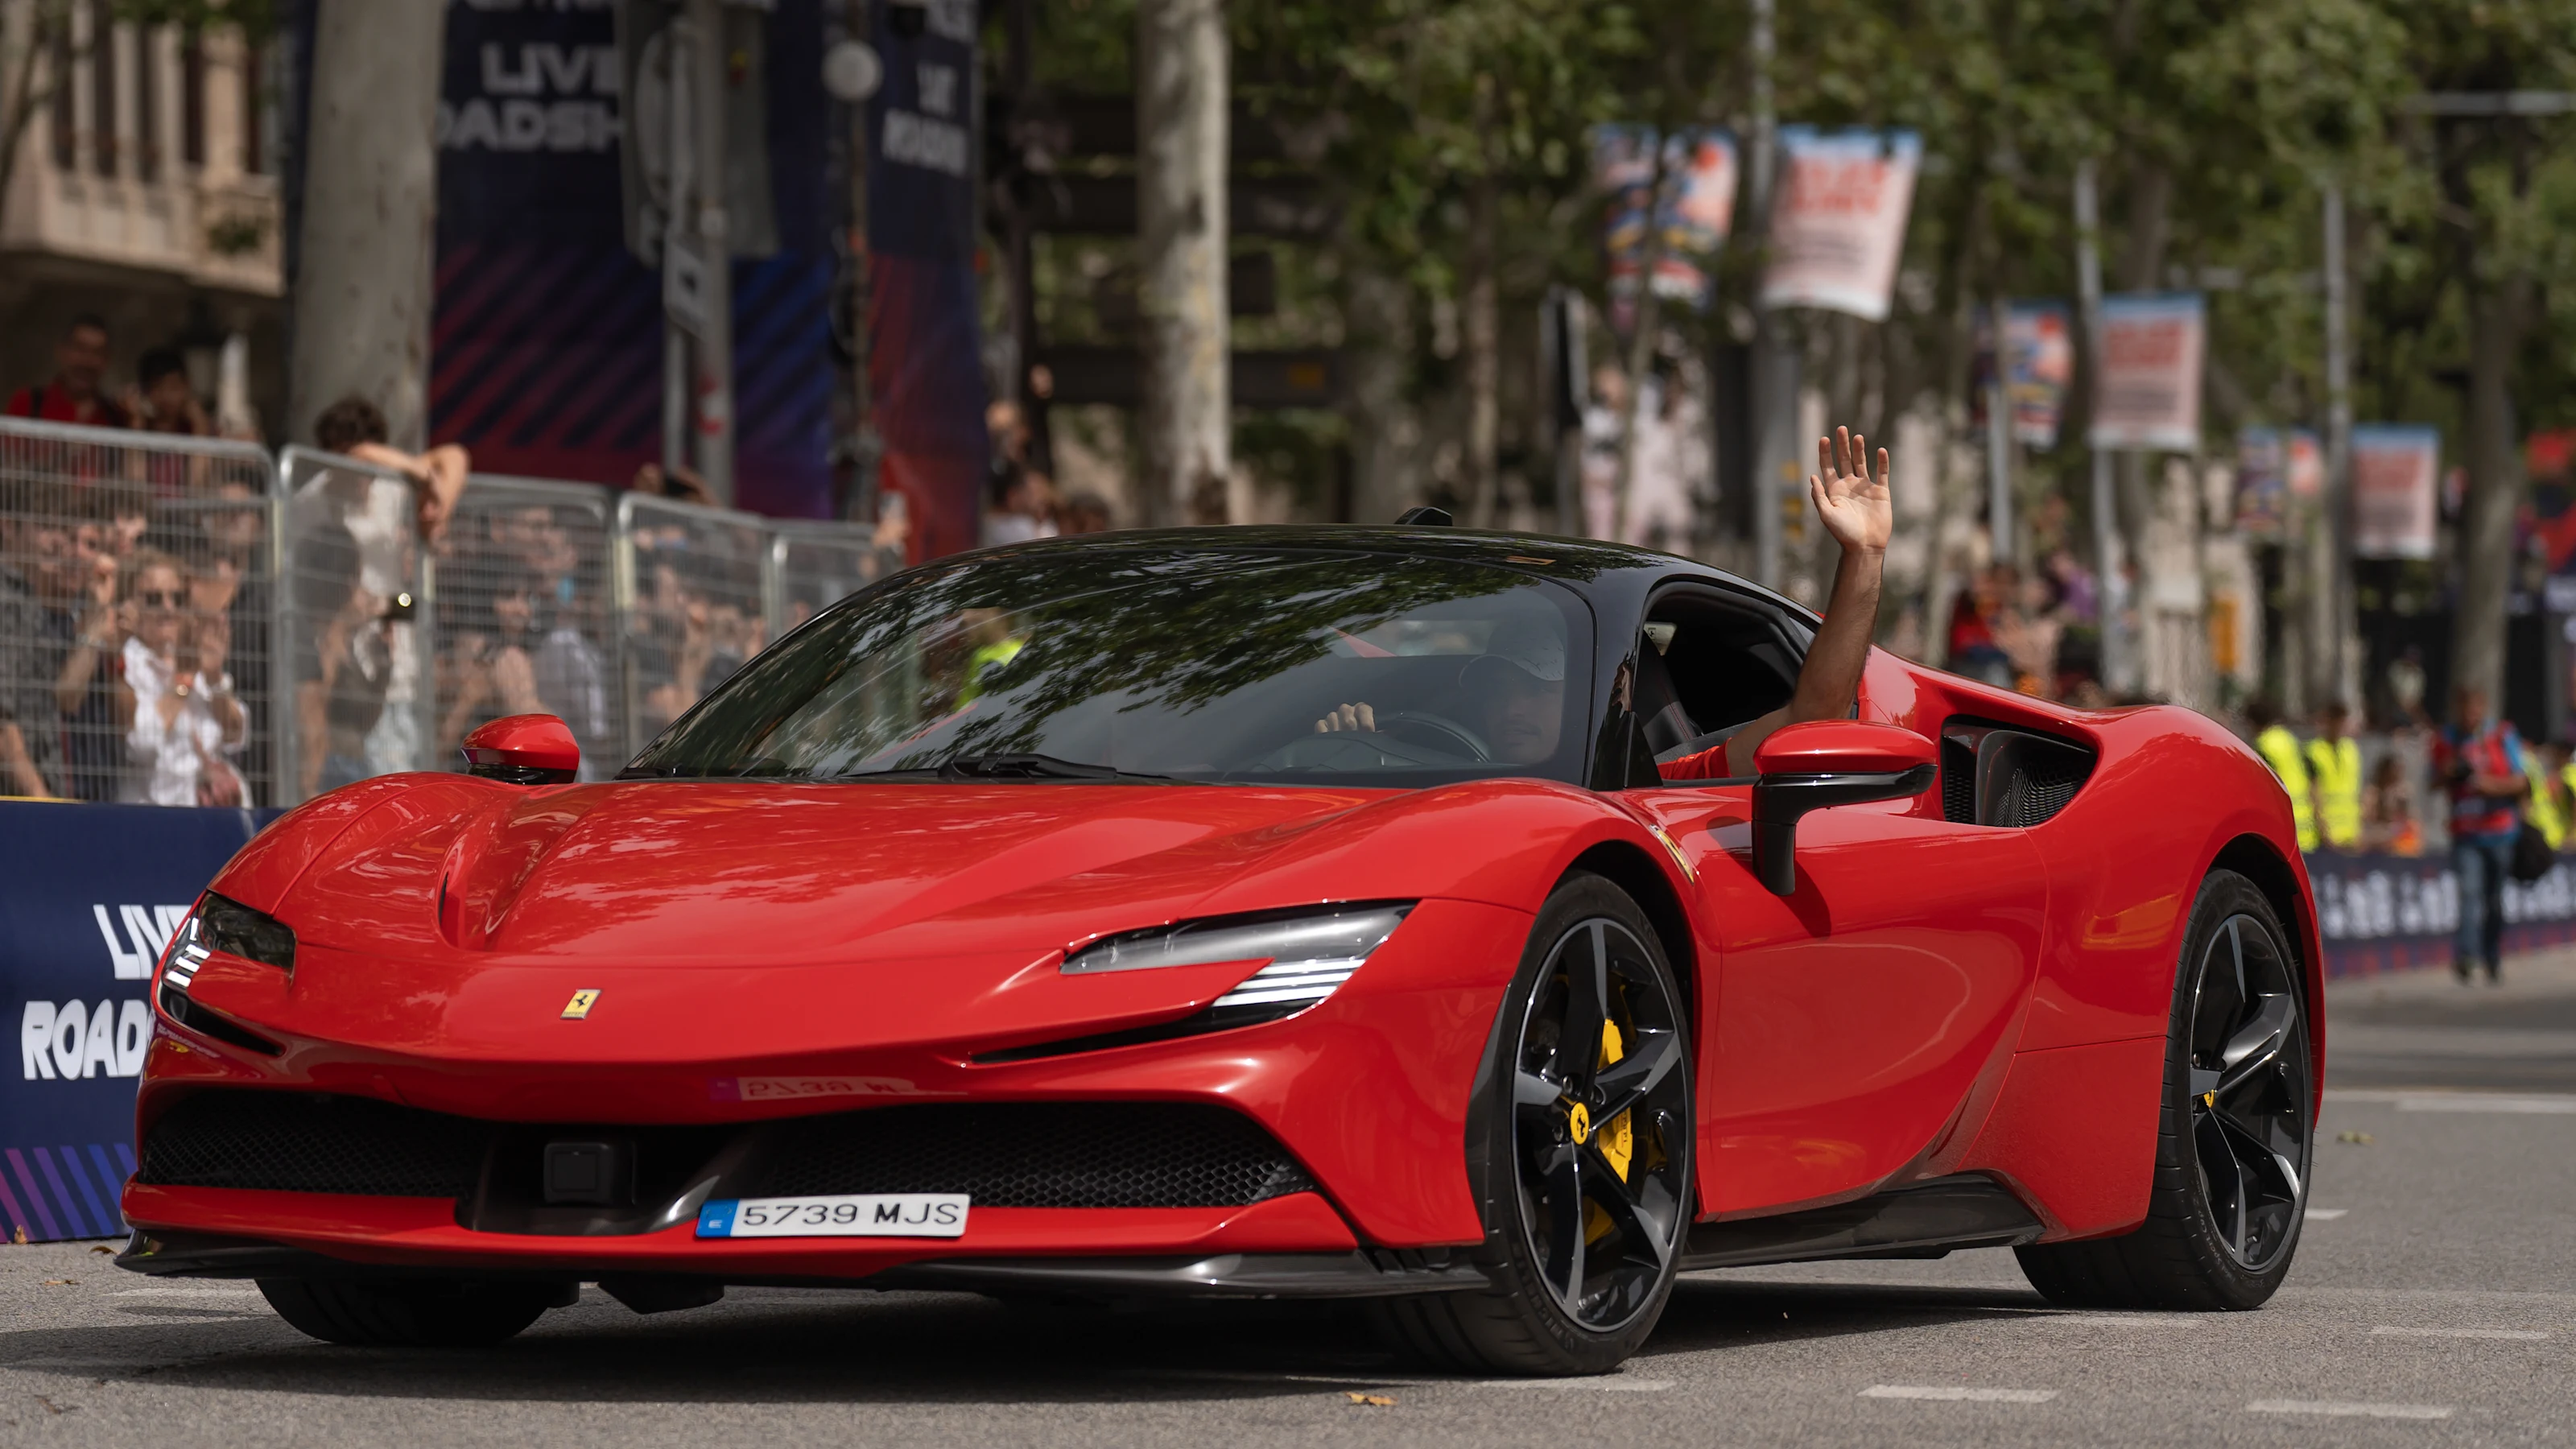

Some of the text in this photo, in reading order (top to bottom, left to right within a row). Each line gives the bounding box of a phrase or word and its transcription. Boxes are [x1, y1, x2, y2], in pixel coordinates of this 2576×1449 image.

[21, 998, 150, 1080] ROAD
[708, 1203, 960, 1228] E 5739 MJS
